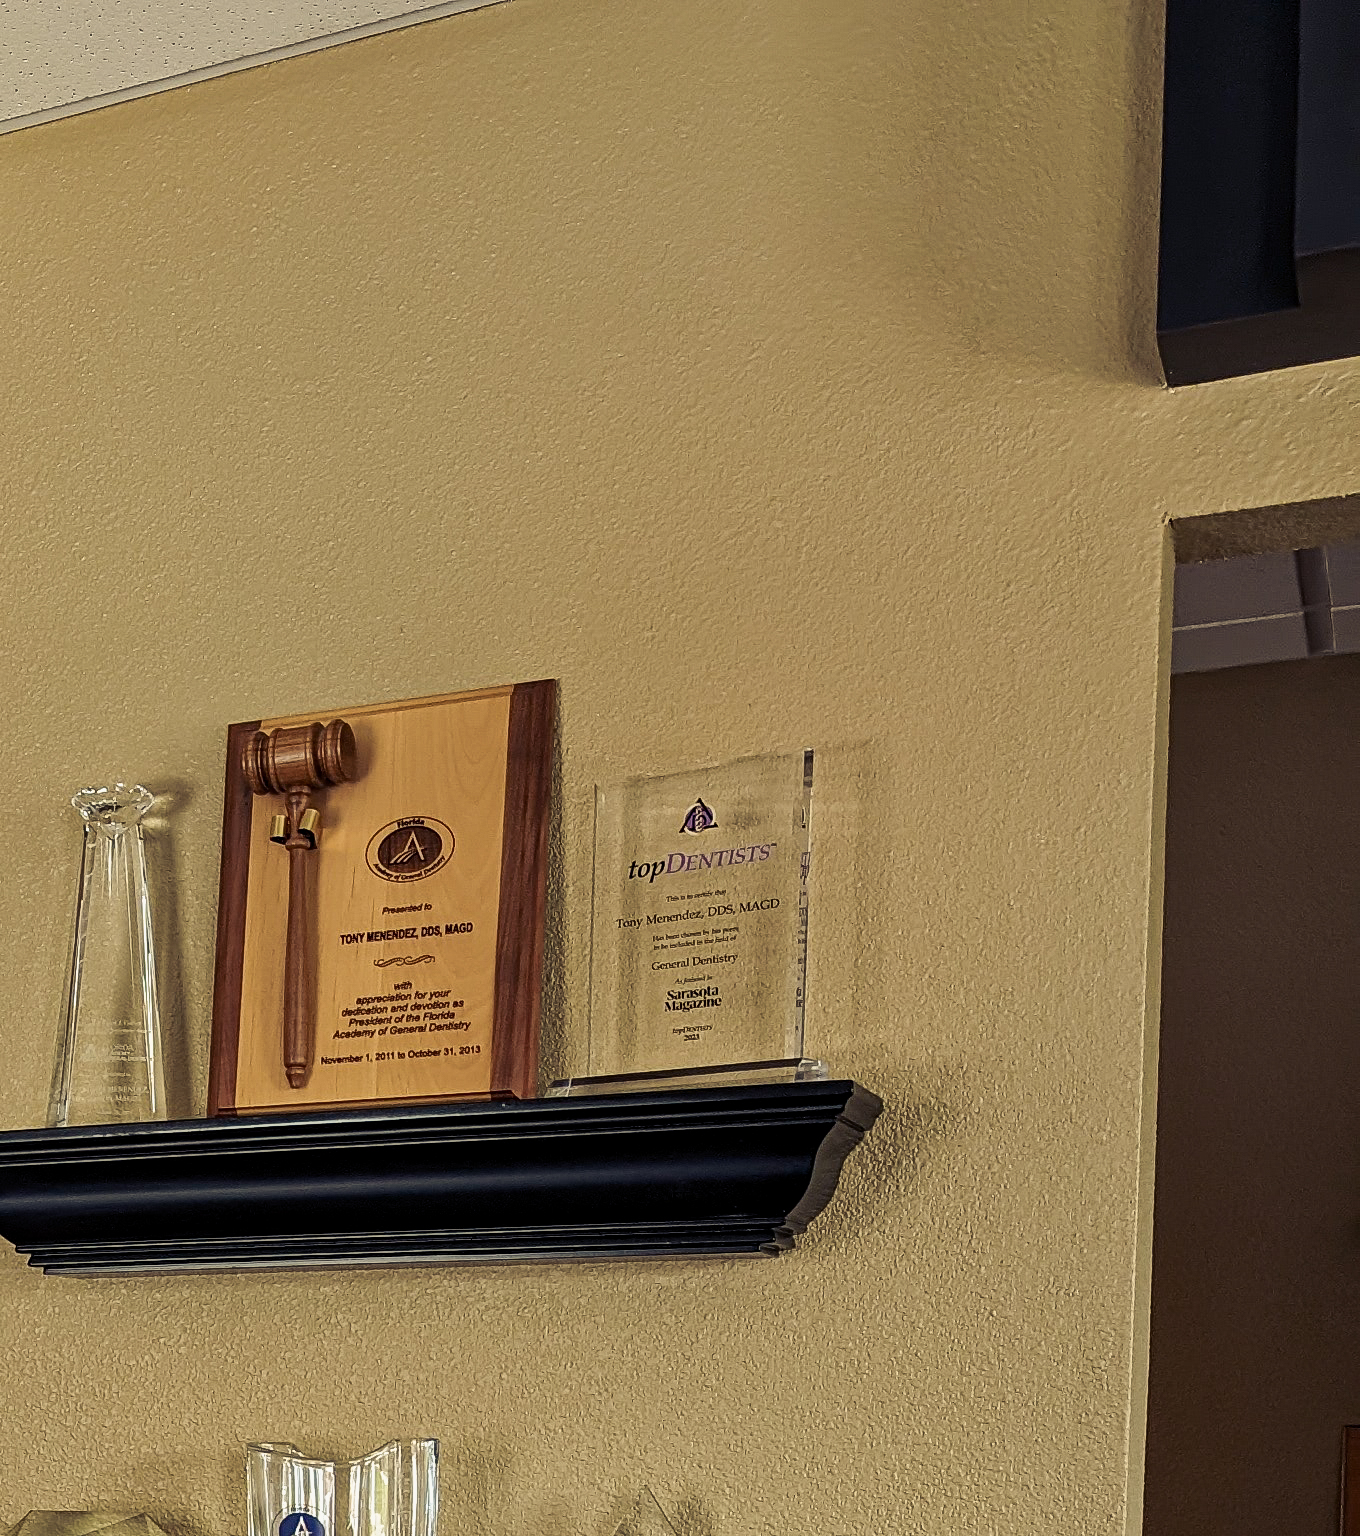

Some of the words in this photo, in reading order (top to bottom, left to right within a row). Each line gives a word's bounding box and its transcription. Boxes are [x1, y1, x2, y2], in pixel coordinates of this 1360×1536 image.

[382, 903, 423, 915] Presented
[424, 903, 432, 911] to
[616, 918, 643, 930] Tony
[646, 910, 705, 925] Menendez,
[707, 904, 736, 918] DDS,
[739, 898, 781, 914] MAGD
[340, 932, 365, 945] TONY
[366, 927, 419, 943] MENENDEZ,
[421, 925, 443, 938] DDS,
[444, 922, 474, 935] MAGD
[652, 958, 690, 971] General
[692, 953, 739, 966] Dentistry
[393, 981, 413, 990] with
[666, 986, 720, 1001] Sarasota
[356, 993, 411, 1007] appreciation
[414, 990, 428, 1000] for
[429, 989, 452, 1001] your
[664, 997, 723, 1013] Magazine
[341, 1005, 388, 1017] dedication
[390, 1002, 409, 1013] and
[410, 1000, 450, 1011] devotion
[452, 1000, 465, 1008] as
[348, 1015, 393, 1027] President
[394, 1014, 405, 1024] of
[406, 1013, 421, 1022] the
[422, 1010, 456, 1021] Florida
[332, 1028, 376, 1040] Academy
[377, 1026, 388, 1036] of
[389, 1023, 427, 1035] General
[429, 1019, 472, 1033] Dentistry
[321, 1053, 363, 1065] November
[366, 1053, 373, 1063] 1,
[375, 1052, 395, 1062] 2011
[397, 1050, 406, 1060] to
[407, 1048, 442, 1059] October
[443, 1047, 457, 1057] 31,
[459, 1044, 482, 1055] 2013
